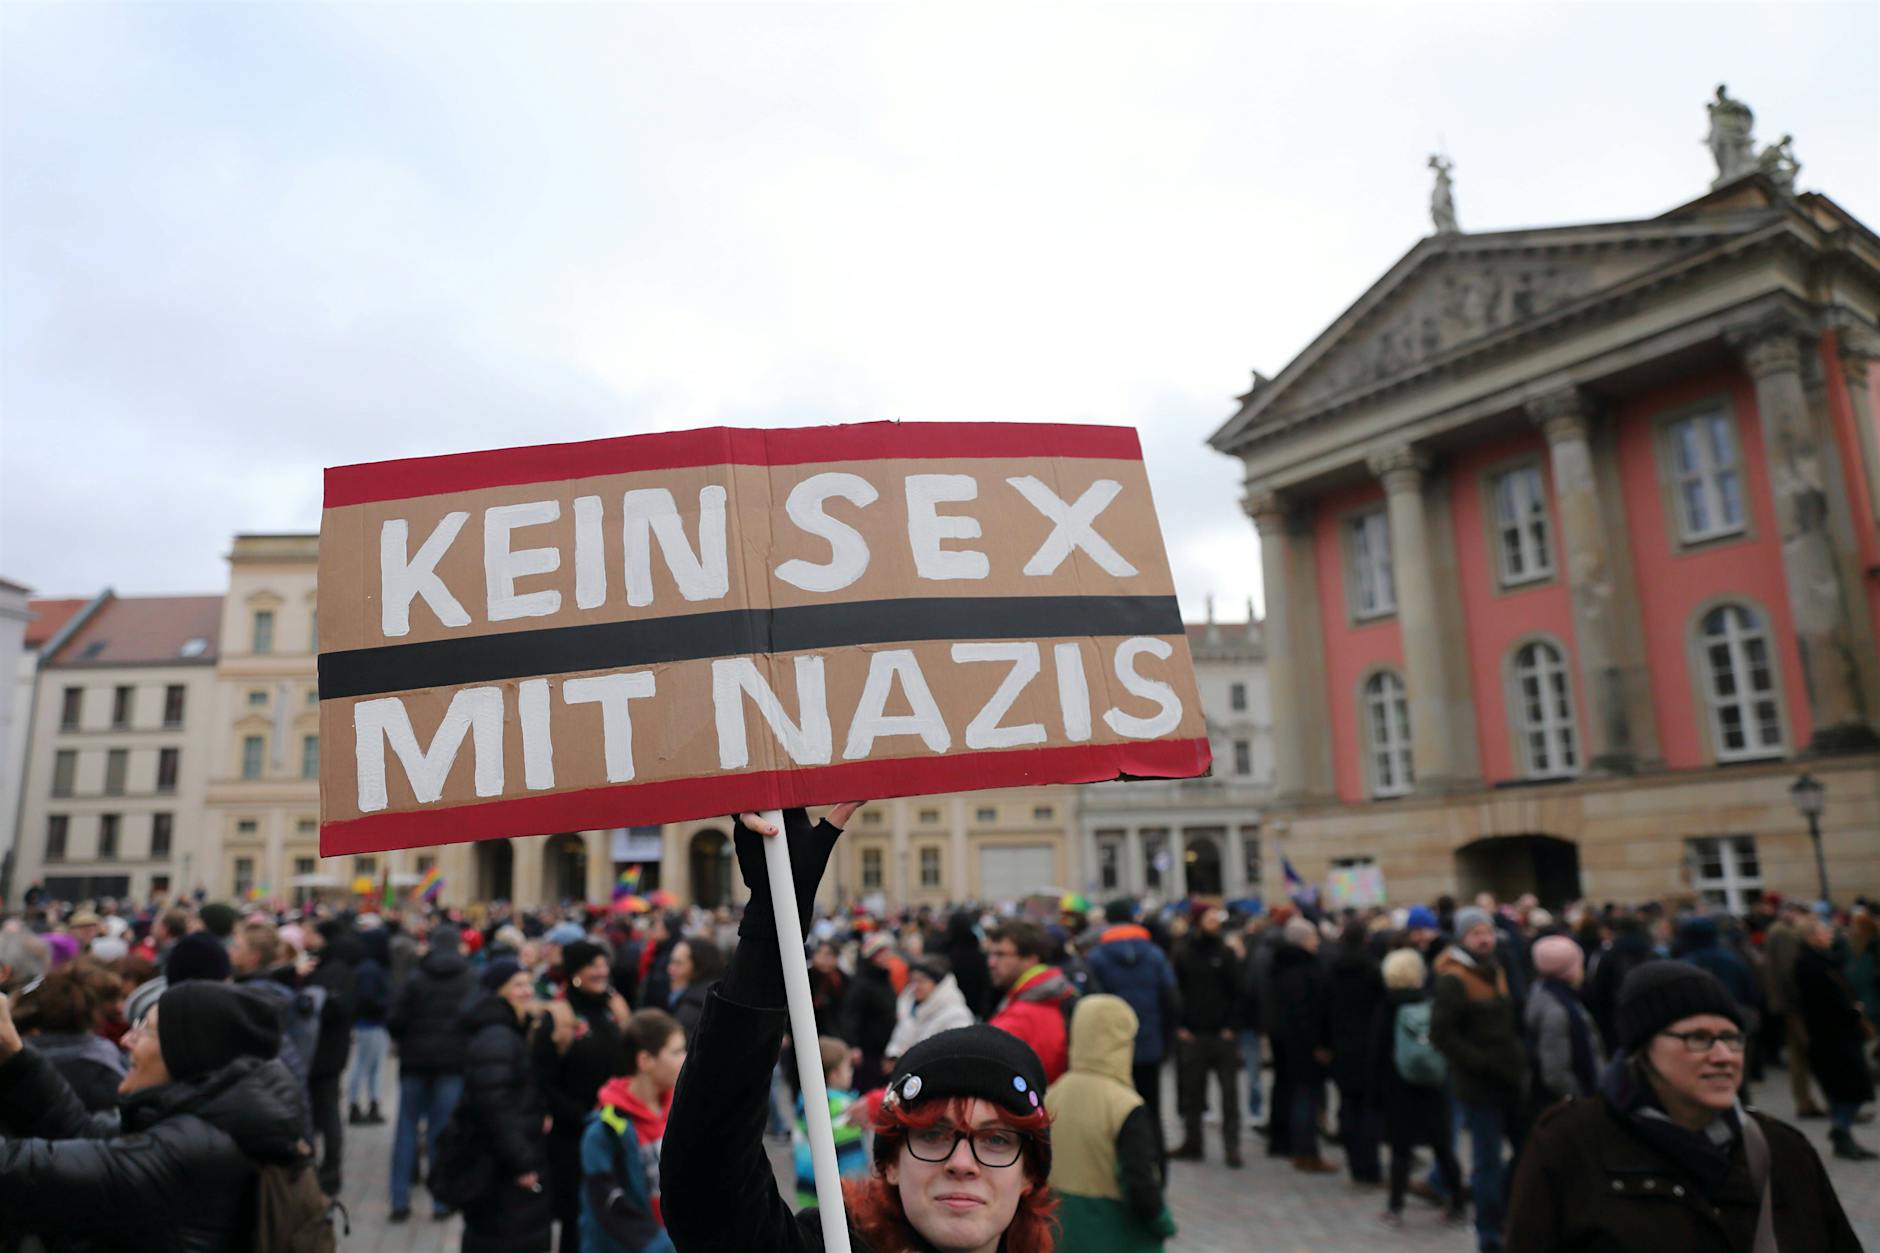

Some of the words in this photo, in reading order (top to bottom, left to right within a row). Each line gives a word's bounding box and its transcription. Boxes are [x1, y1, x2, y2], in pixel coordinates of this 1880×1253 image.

[380, 485, 728, 636] KEIN
[775, 472, 1138, 593] SEX
[354, 671, 655, 812] MIT
[713, 637, 1183, 769] NAZIS
